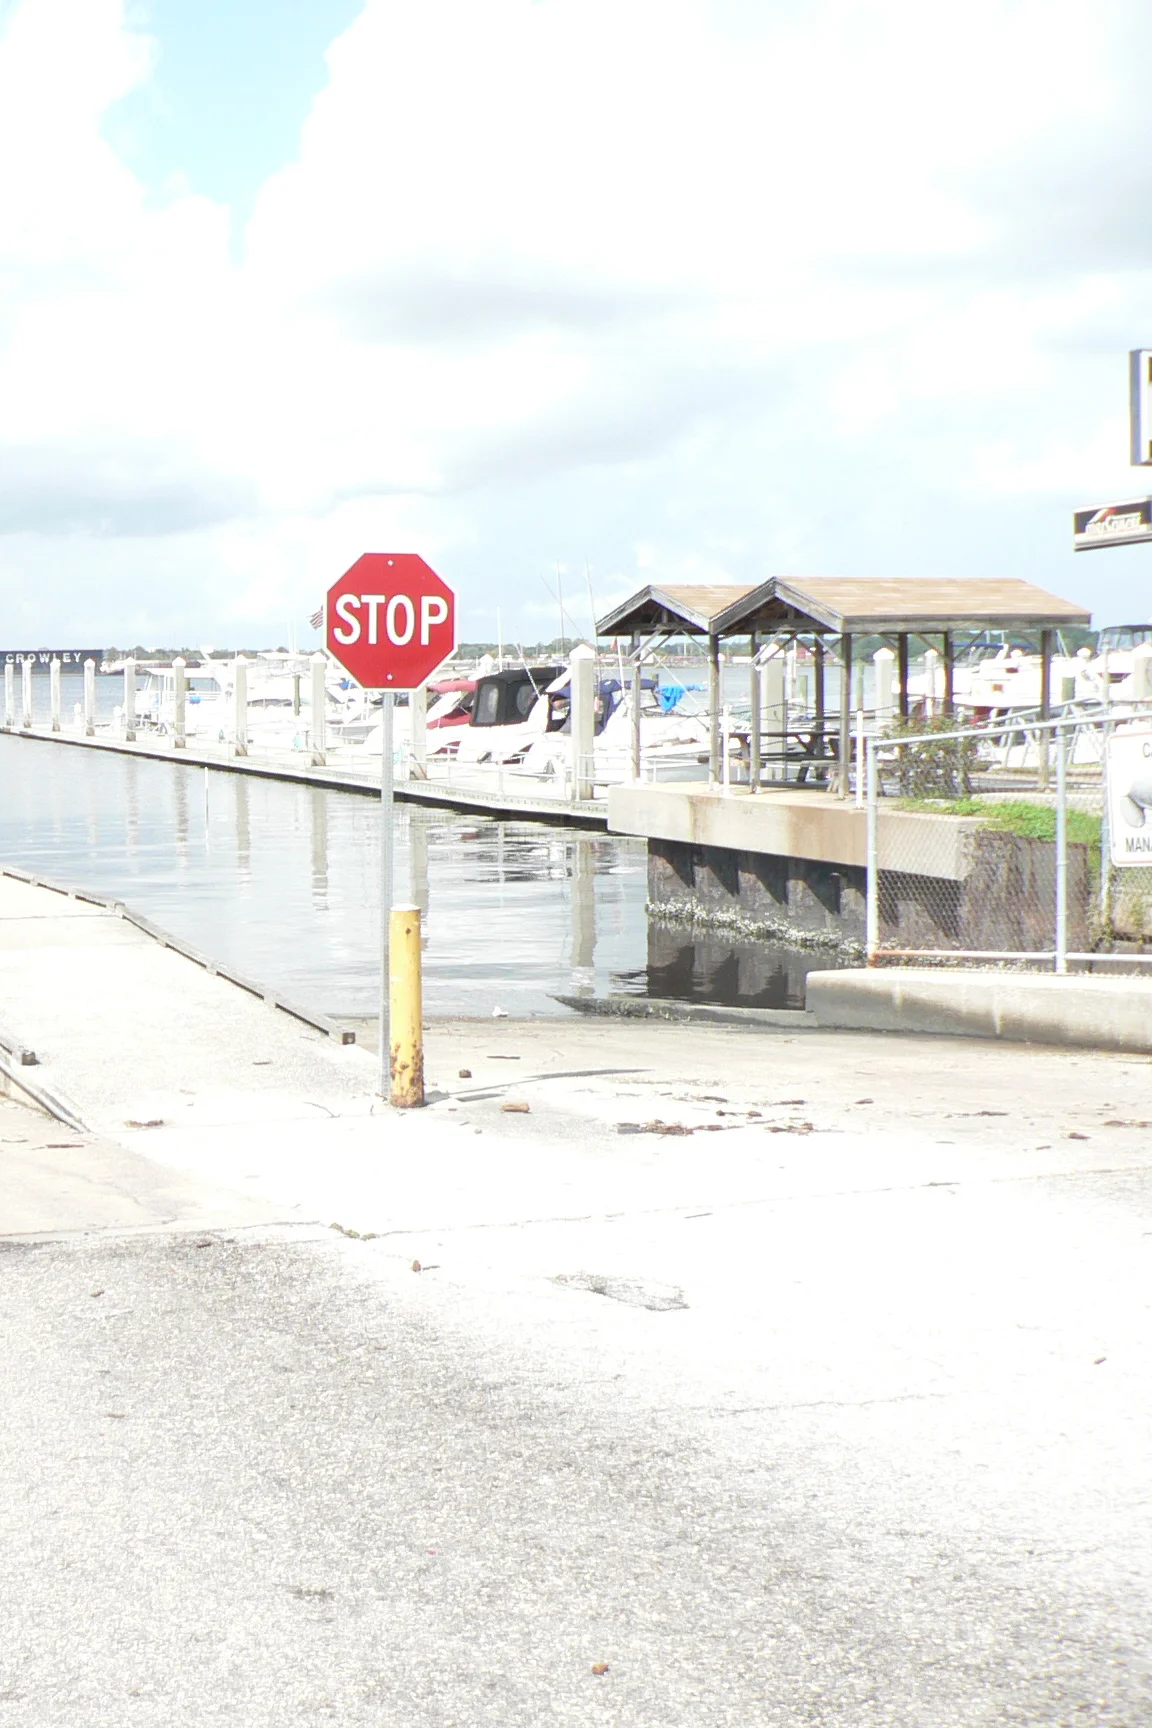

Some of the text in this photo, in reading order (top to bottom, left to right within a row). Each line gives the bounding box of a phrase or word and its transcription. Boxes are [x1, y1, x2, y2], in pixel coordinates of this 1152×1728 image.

[333, 593, 448, 646] STOP
[5, 652, 82, 664] CROWLEY
[1125, 836, 1152, 853] MAN
